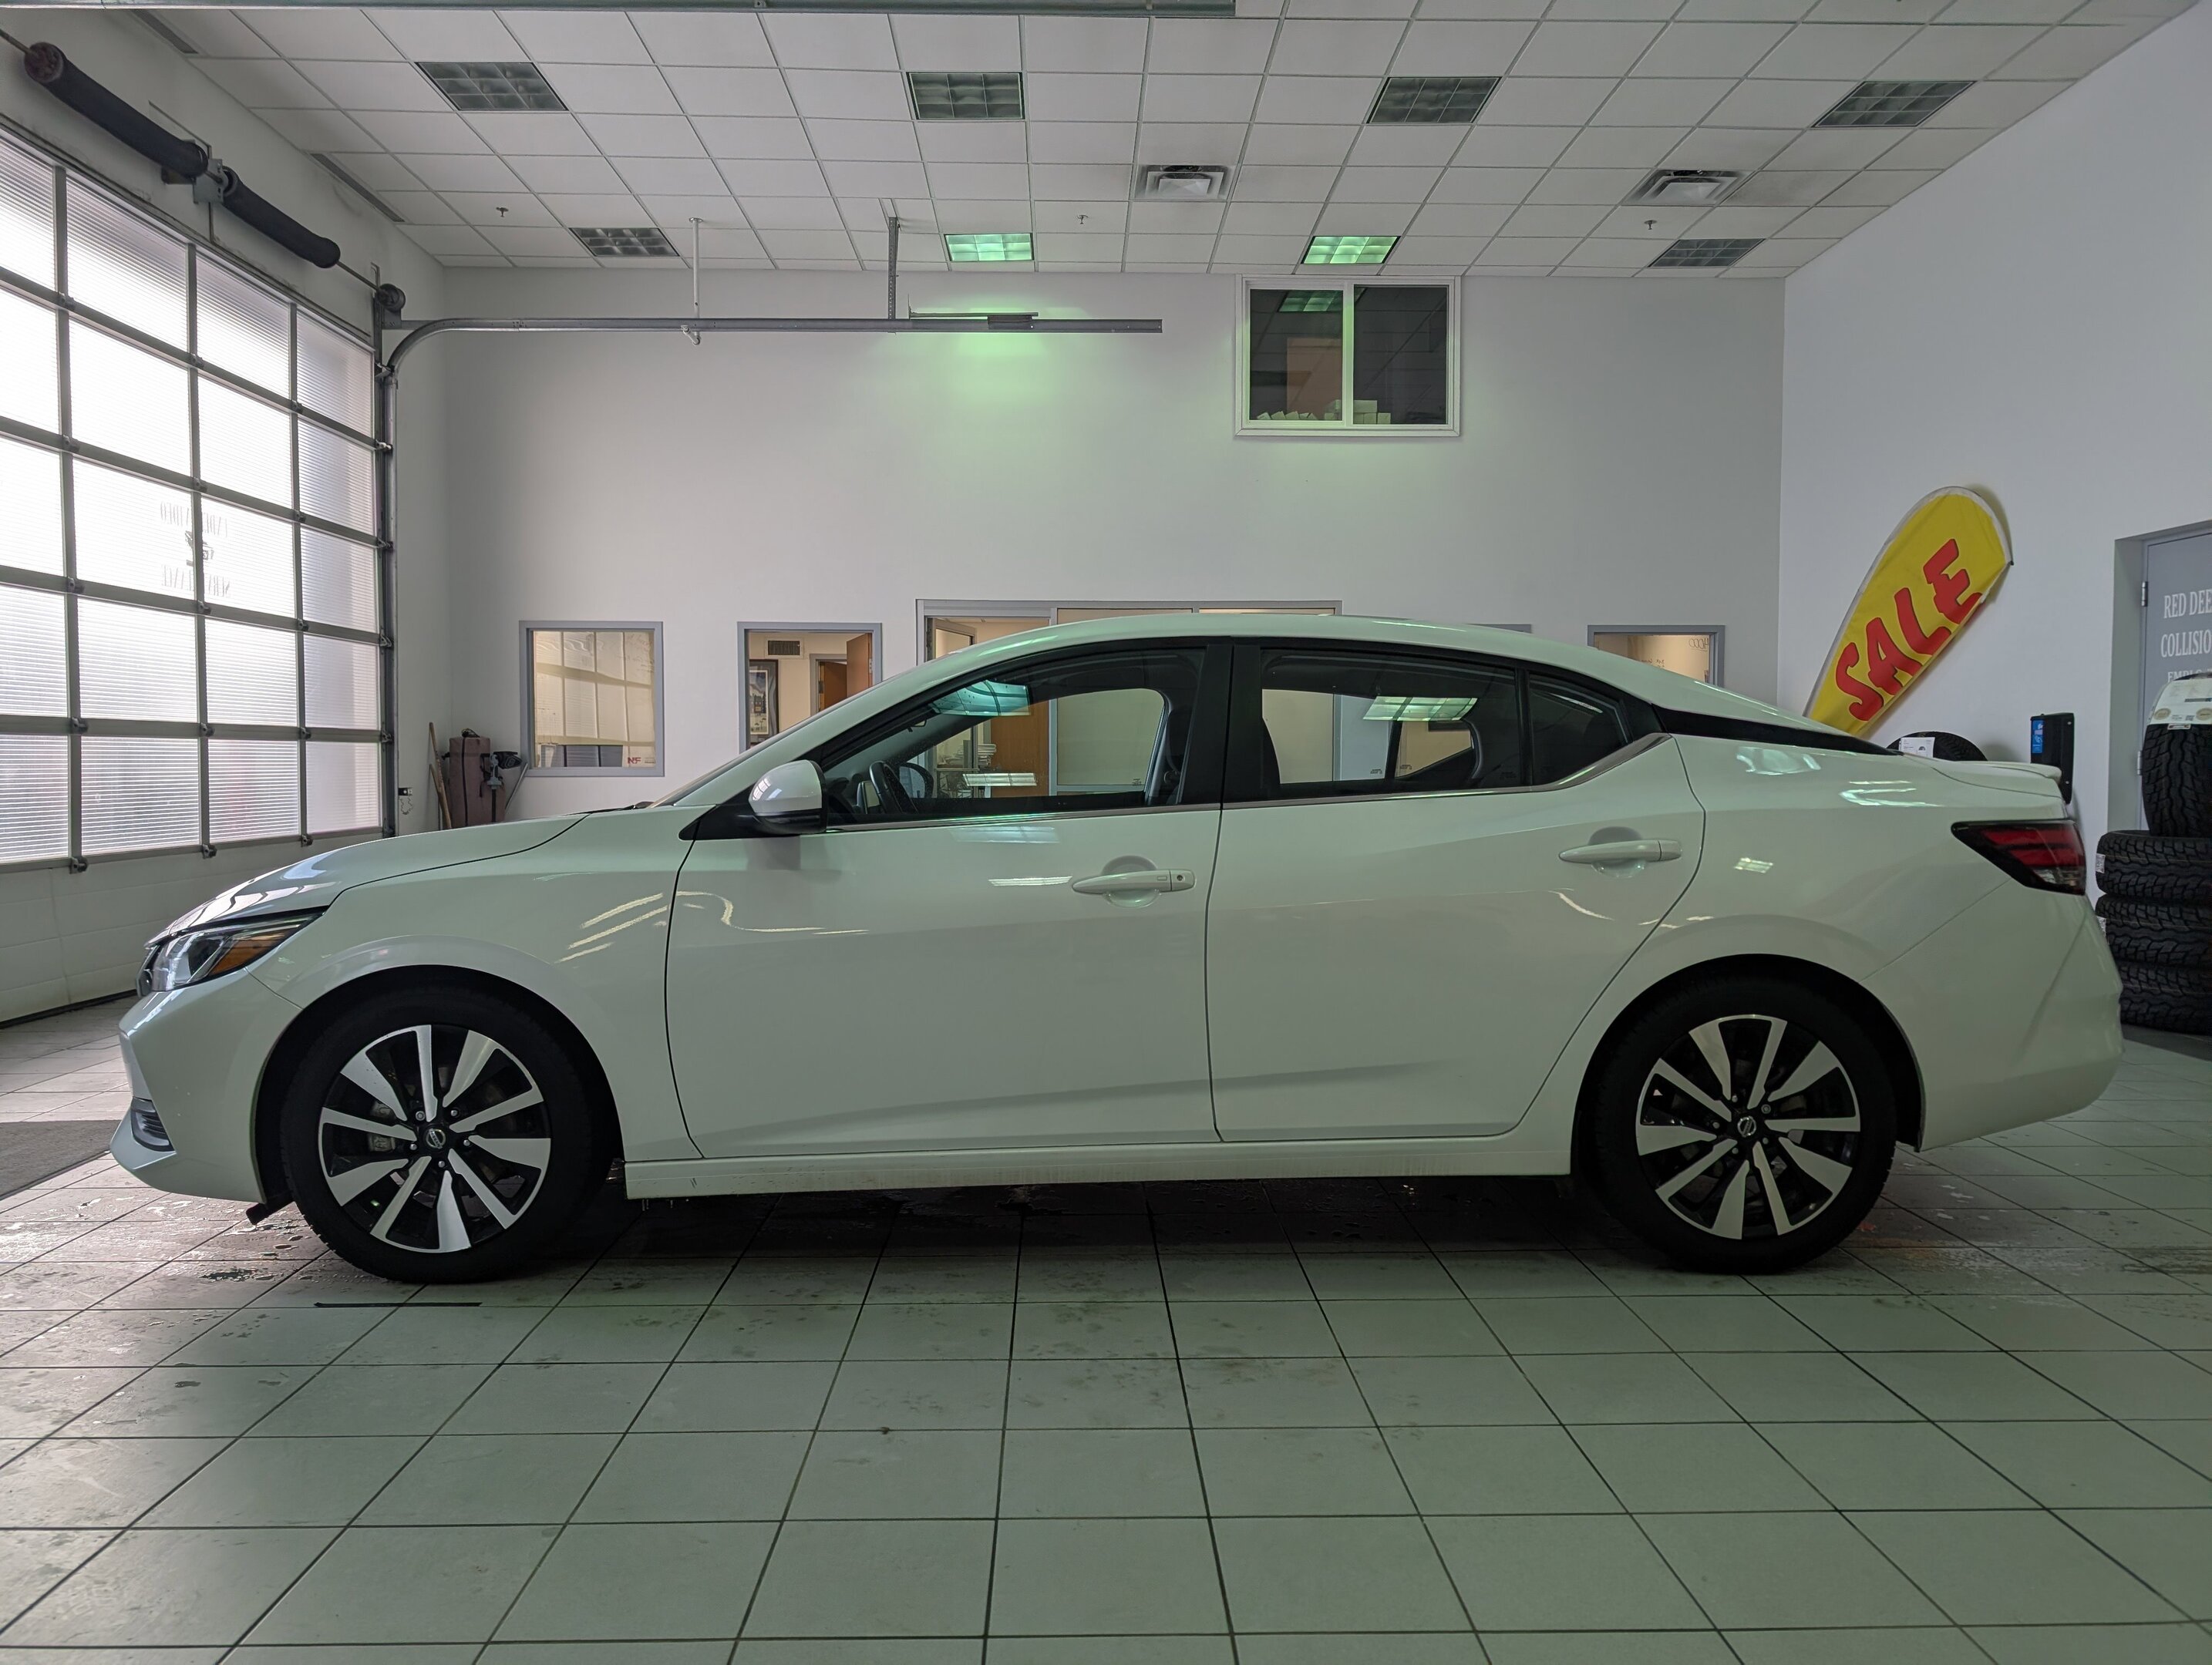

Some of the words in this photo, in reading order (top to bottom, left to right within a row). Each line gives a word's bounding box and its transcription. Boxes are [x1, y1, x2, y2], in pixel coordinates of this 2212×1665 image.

[2163, 593, 2187, 618] RED
[1835, 538, 1982, 722] SALE
[2160, 629, 2212, 658] COLLISIO
